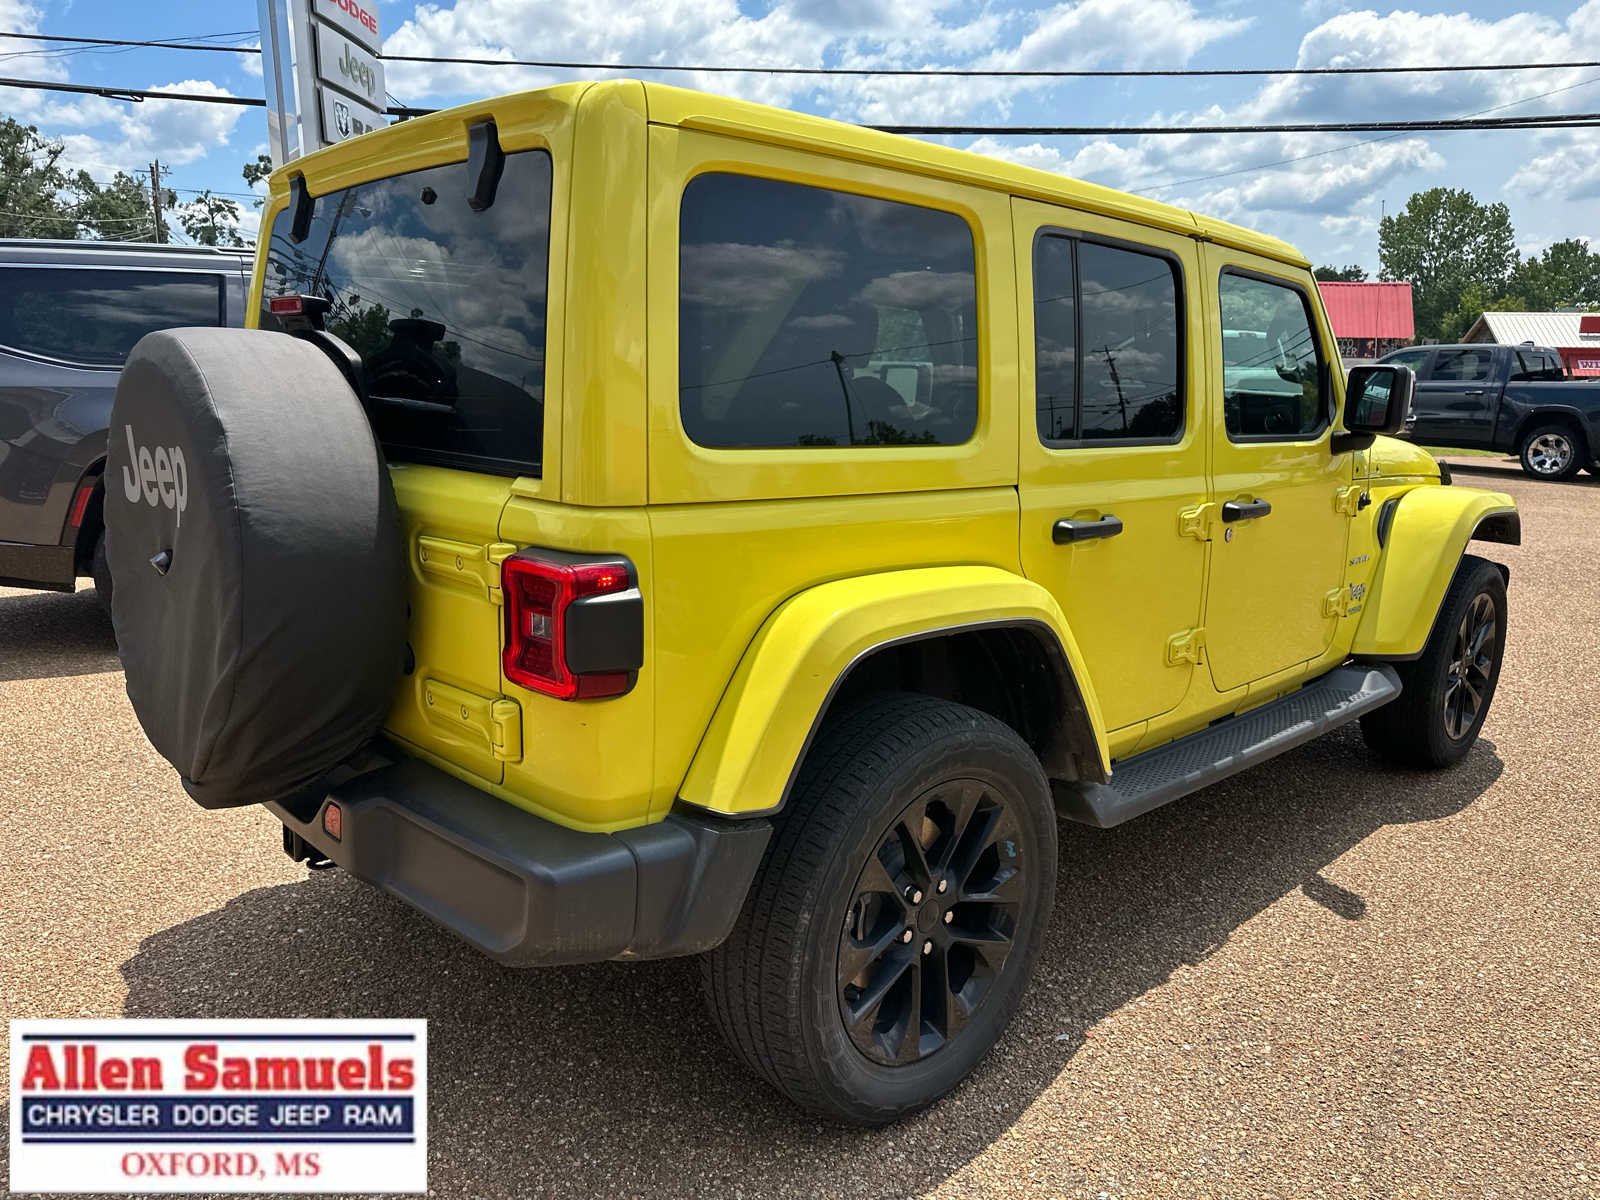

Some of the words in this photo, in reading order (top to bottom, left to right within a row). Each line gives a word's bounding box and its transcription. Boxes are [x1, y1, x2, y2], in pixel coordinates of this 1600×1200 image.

[329, 0, 377, 34] ODGE
[339, 43, 376, 97] Jeep
[122, 424, 188, 529] Jeep
